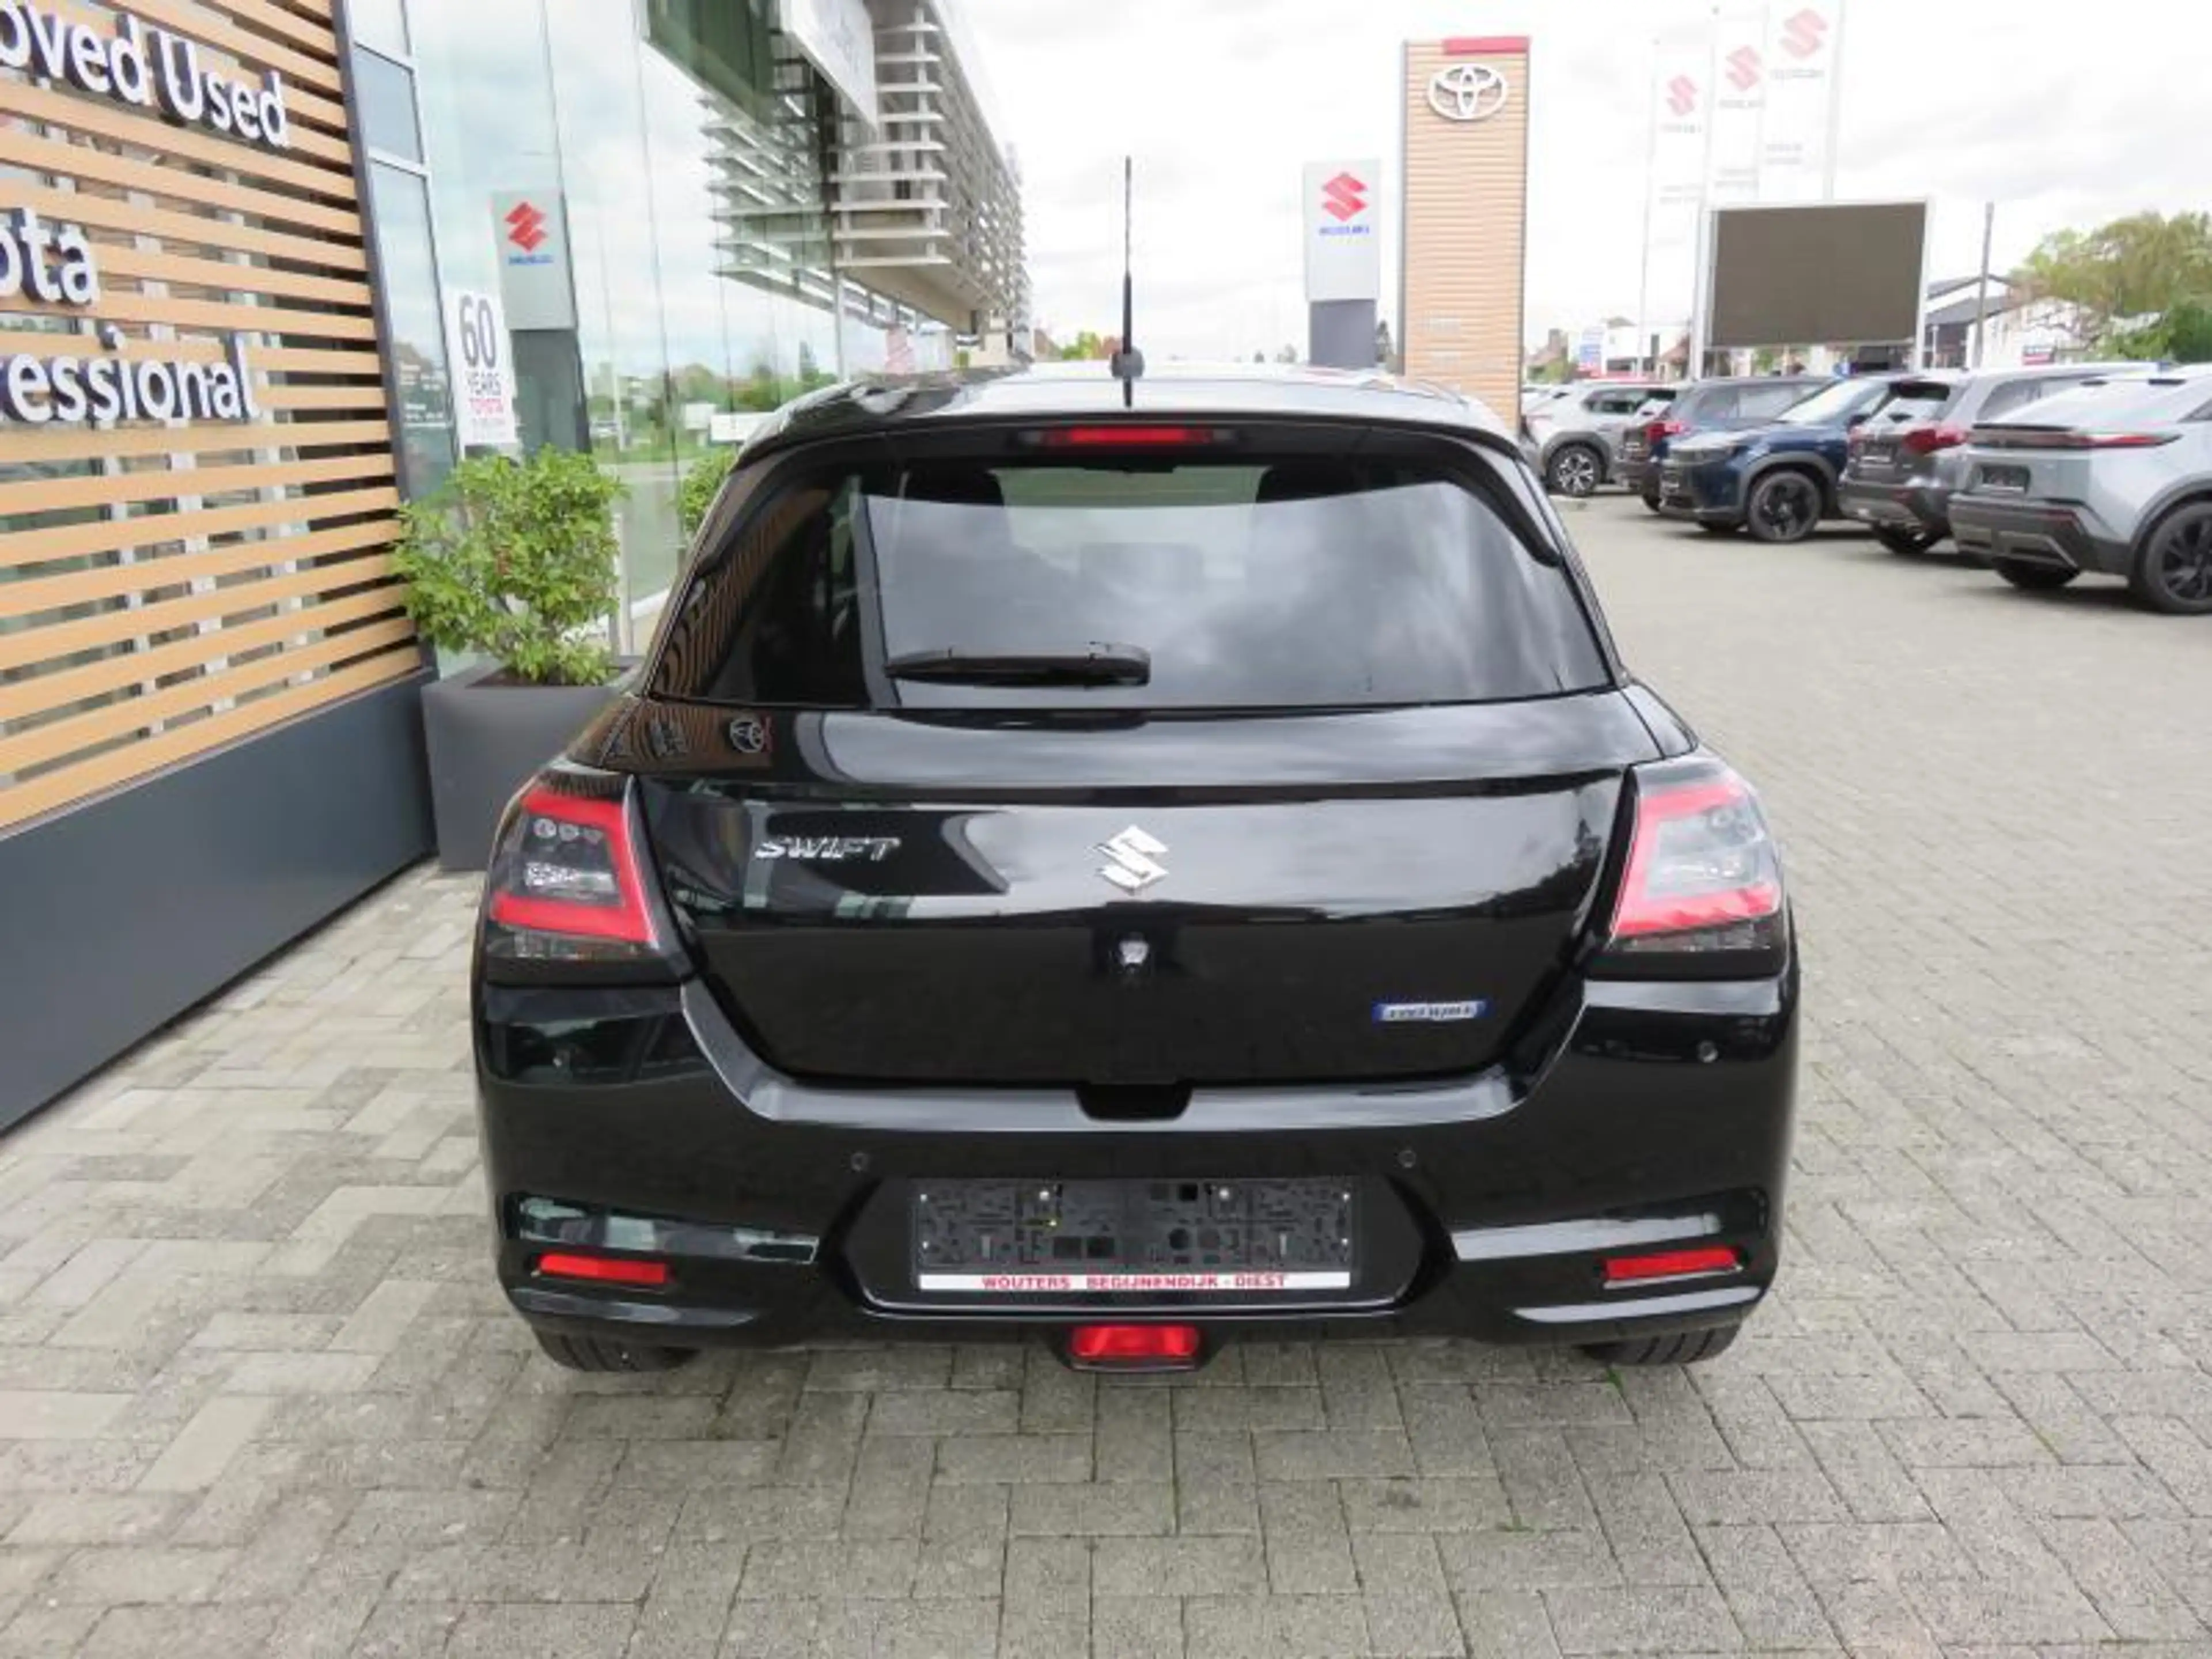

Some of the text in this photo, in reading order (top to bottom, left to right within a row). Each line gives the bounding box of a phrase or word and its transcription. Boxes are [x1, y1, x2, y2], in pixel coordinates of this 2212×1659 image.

[153, 30, 290, 148] Used
[460, 294, 496, 368] 60
[0, 324, 260, 422] essional
[755, 835, 902, 861] SWIFT
[982, 1275, 1071, 1289] WOUTERS
[1234, 1274, 1285, 1288] DIEST
